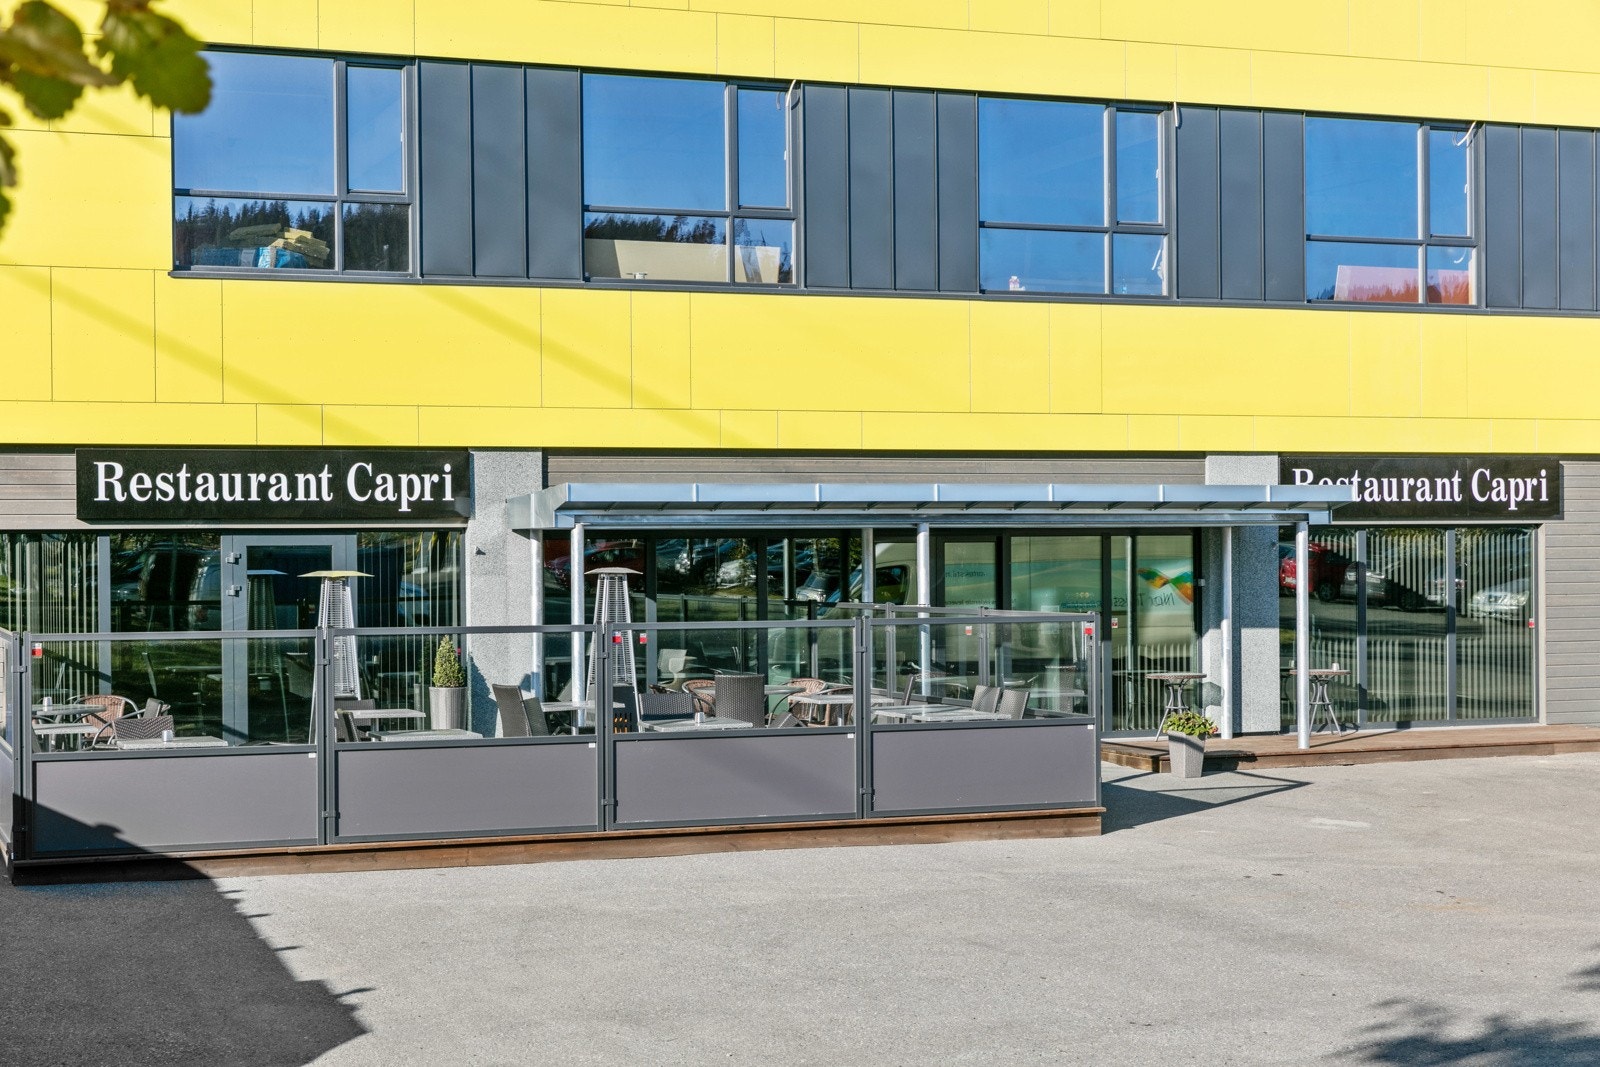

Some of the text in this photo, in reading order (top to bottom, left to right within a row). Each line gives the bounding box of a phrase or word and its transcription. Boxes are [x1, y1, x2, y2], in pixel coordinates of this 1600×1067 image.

[94, 462, 455, 512] Restaurant Capri
[1471, 468, 1549, 511] Capri
